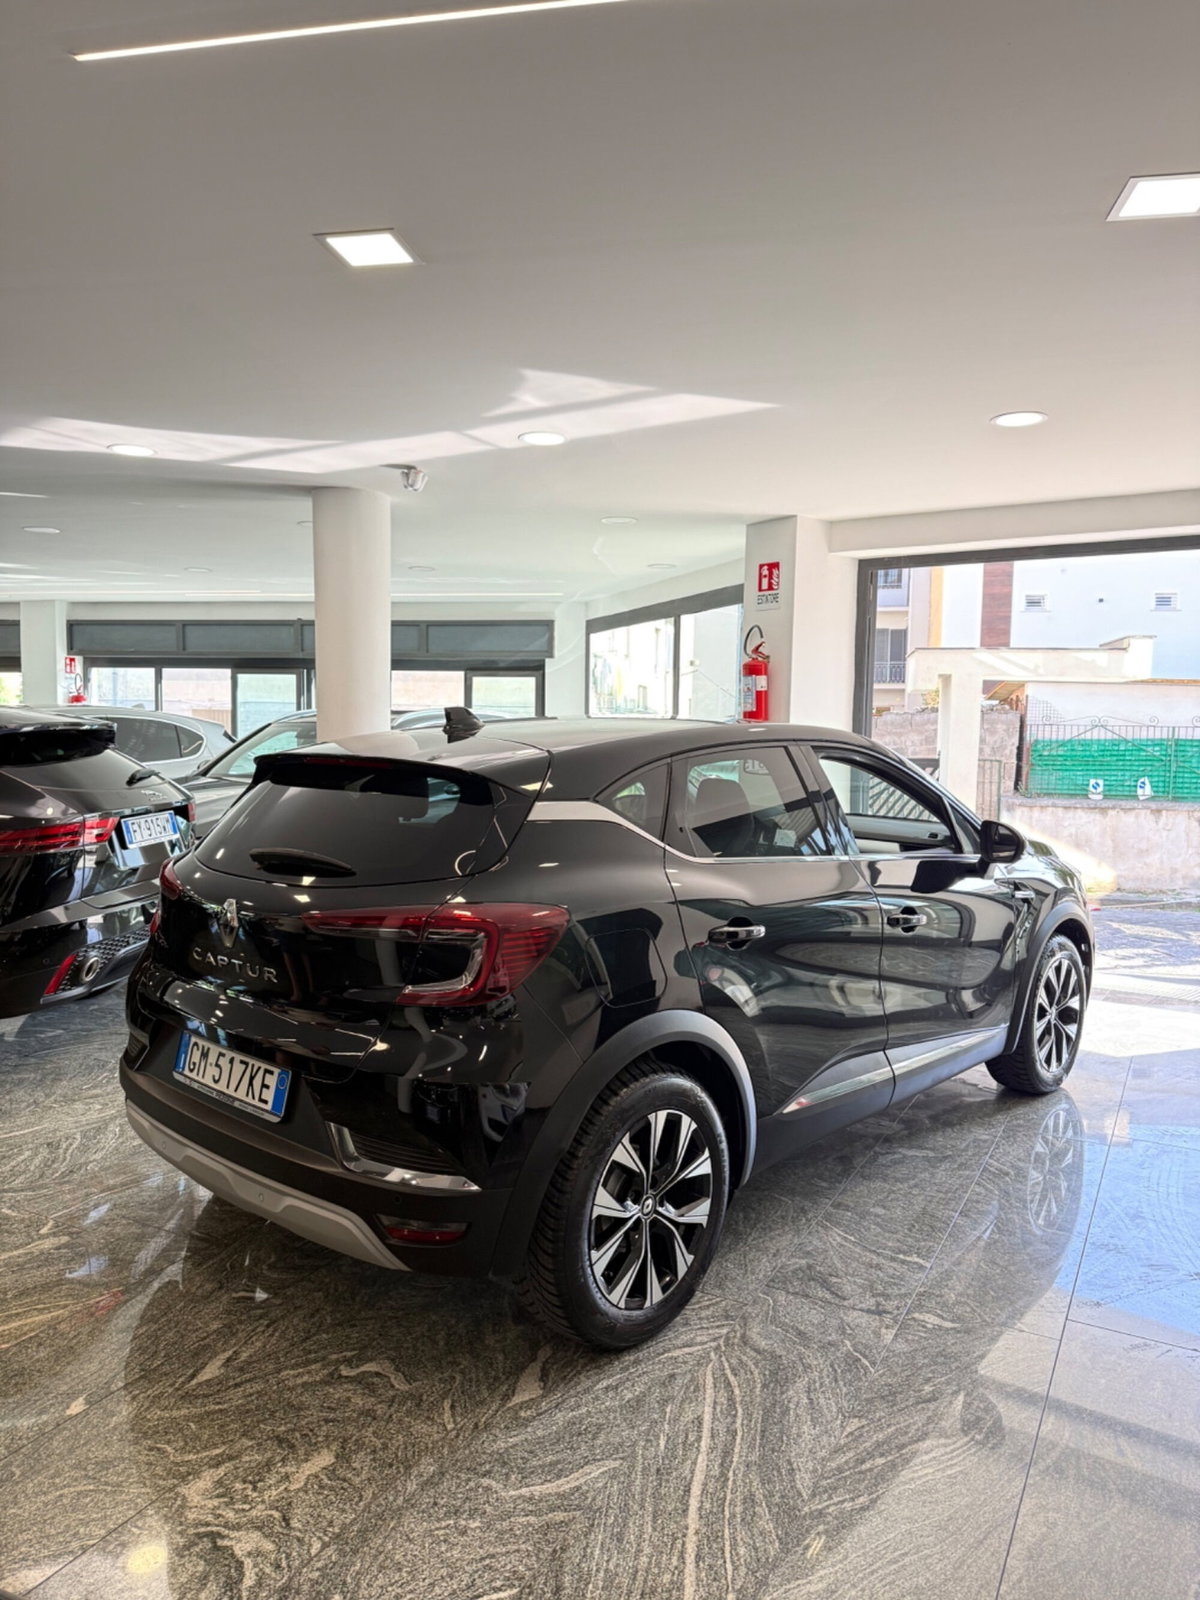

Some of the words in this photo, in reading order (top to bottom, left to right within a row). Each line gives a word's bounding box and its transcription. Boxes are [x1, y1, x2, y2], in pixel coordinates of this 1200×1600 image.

[192, 947, 278, 983] CAPTUR
[188, 1041, 211, 1079] GM
[212, 1052, 275, 1105] 517KE
